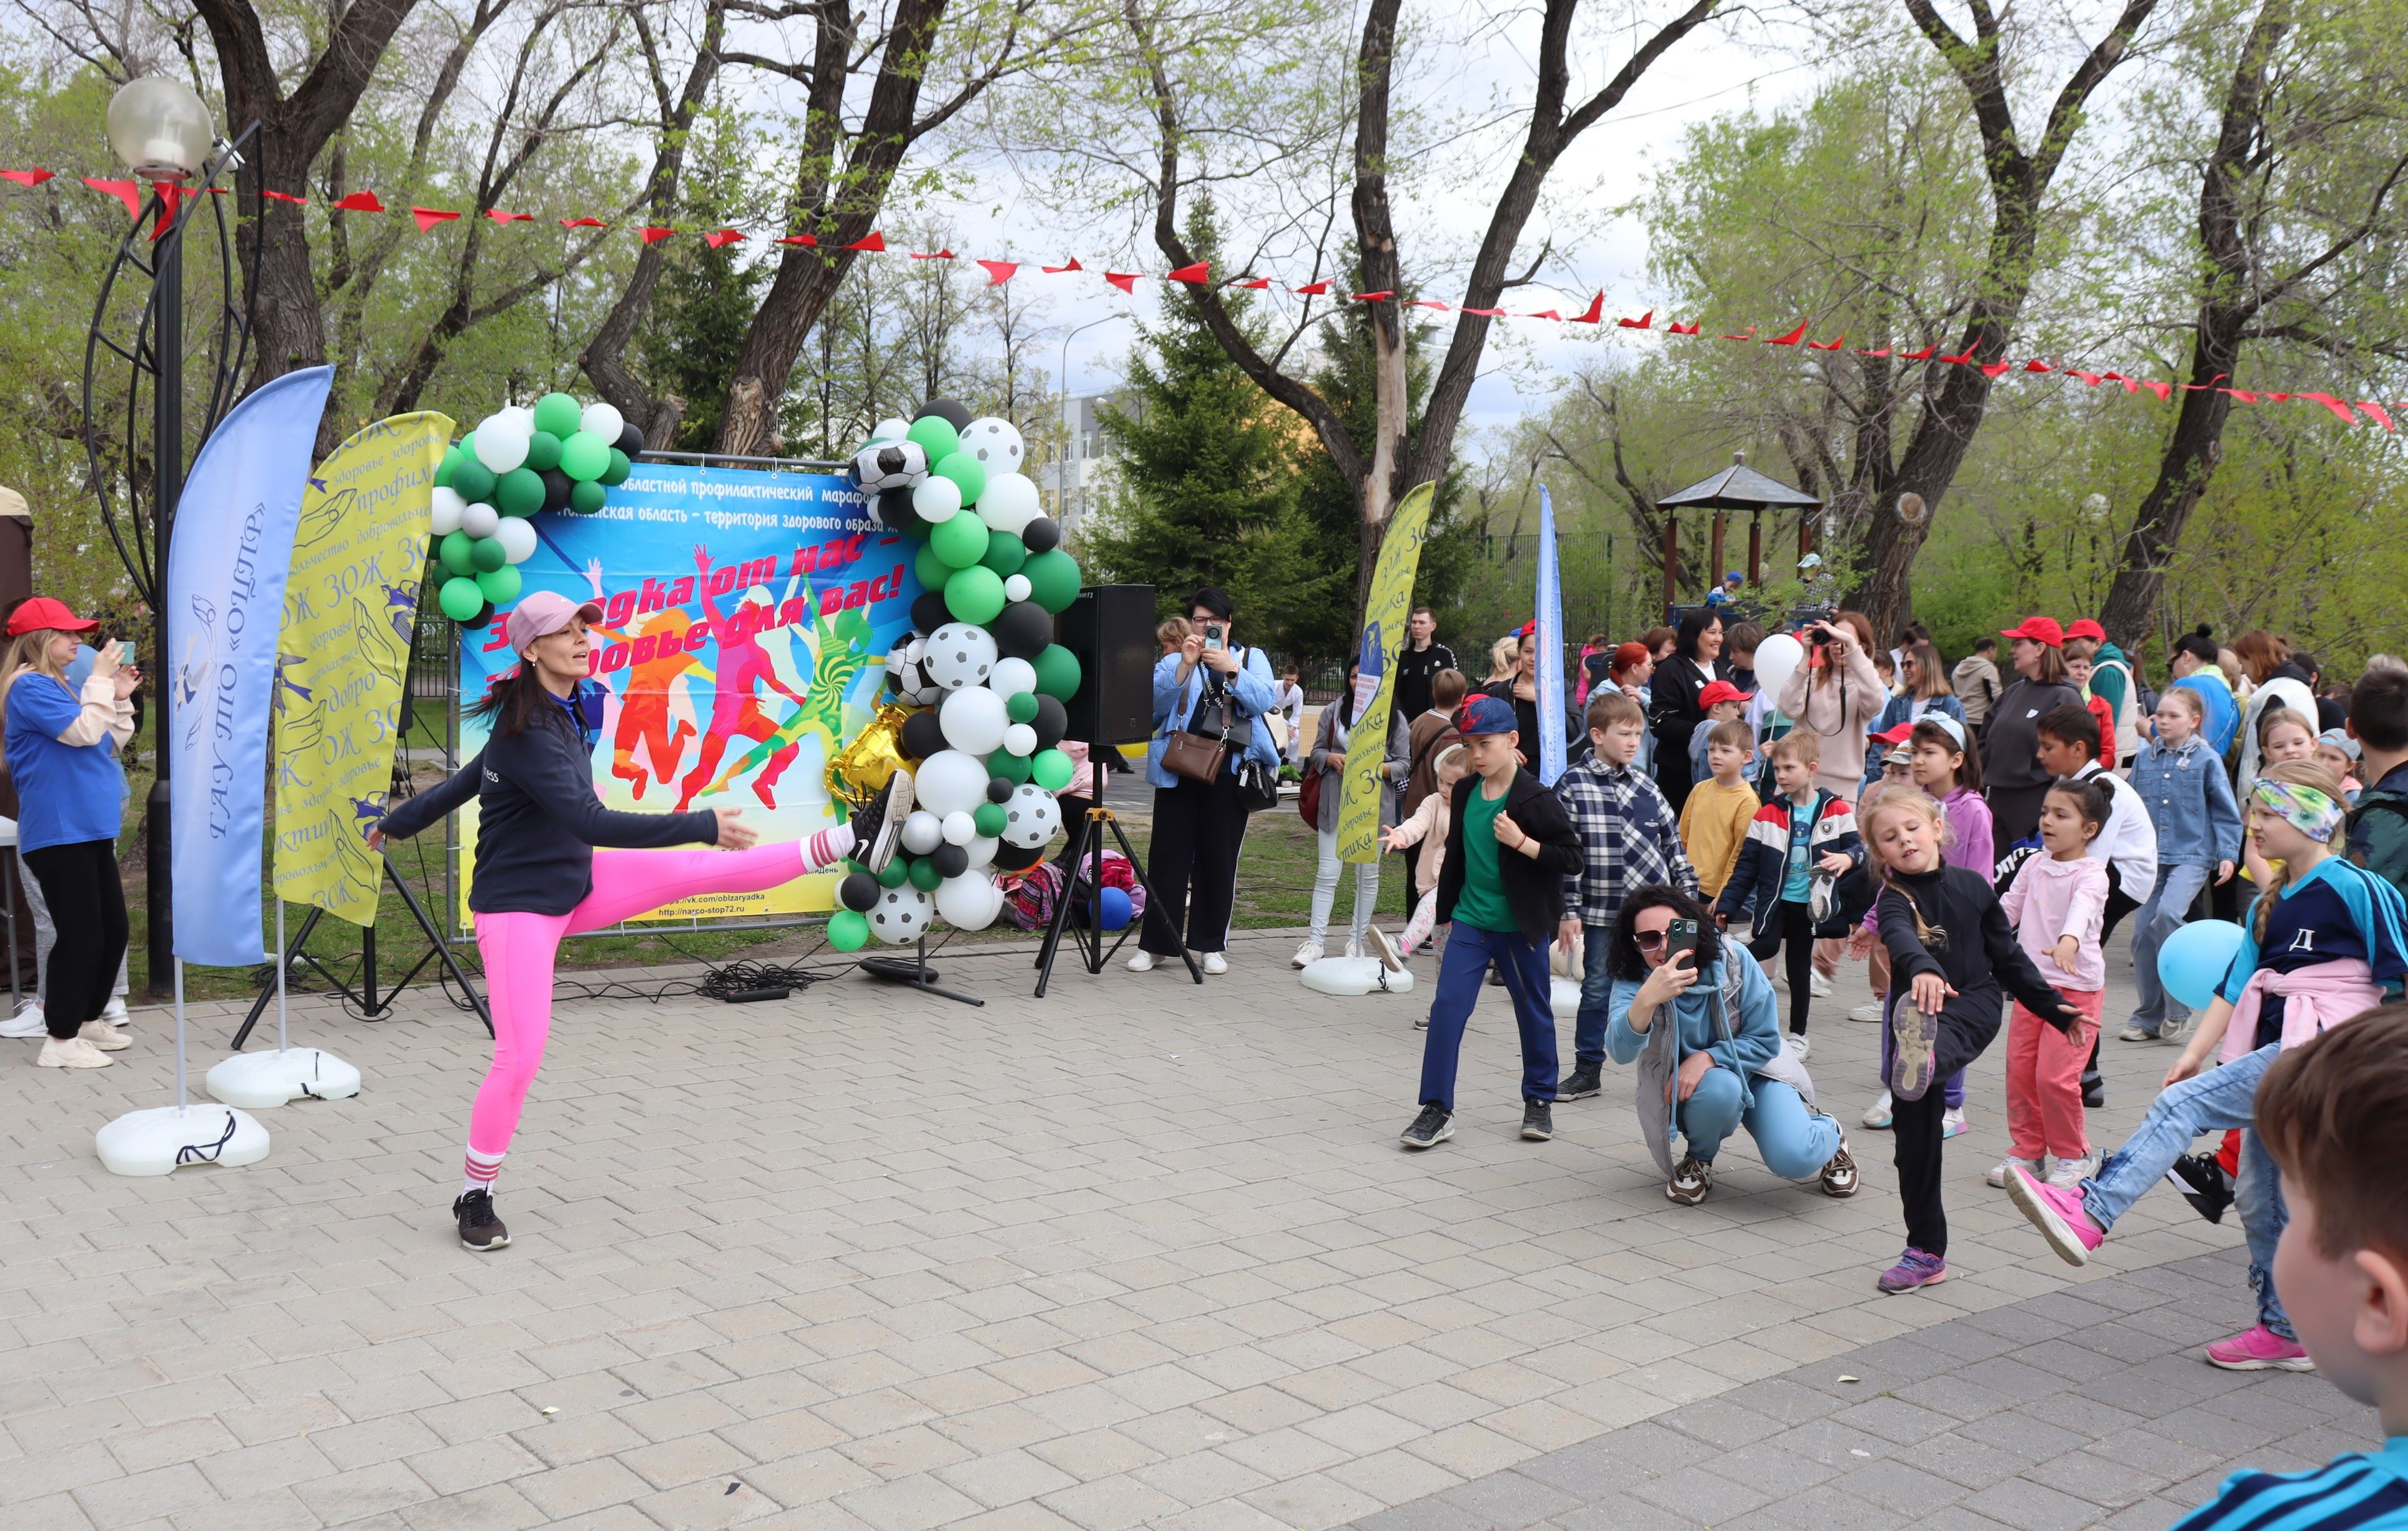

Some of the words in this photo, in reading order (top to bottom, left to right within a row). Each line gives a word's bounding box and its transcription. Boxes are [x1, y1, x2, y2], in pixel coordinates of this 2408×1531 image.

[690, 482, 813, 502] профилактический
[638, 507, 687, 523] область
[704, 511, 778, 531] территория
[782, 515, 842, 533] здорового
[845, 518, 883, 536] образа
[324, 549, 392, 609] ЗОЖ
[710, 555, 778, 596] от
[789, 532, 865, 576] нас
[818, 564, 905, 617] вас!
[210, 741, 234, 839] ГАУ
[2289, 928, 2316, 952] Д
